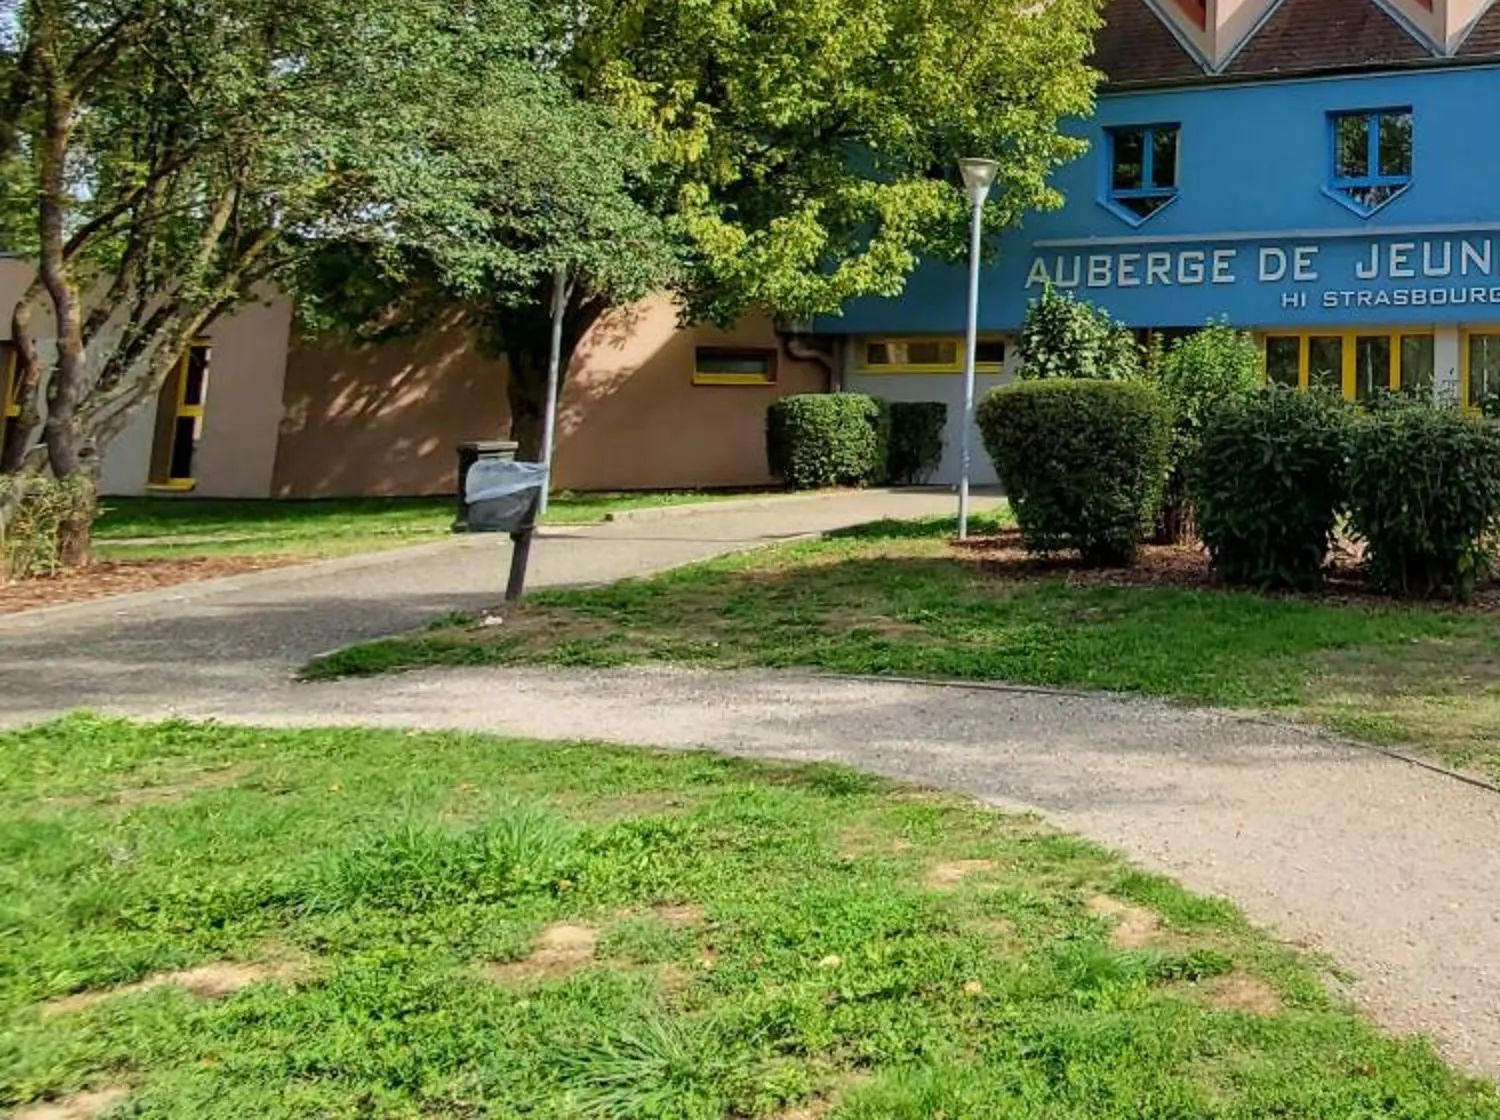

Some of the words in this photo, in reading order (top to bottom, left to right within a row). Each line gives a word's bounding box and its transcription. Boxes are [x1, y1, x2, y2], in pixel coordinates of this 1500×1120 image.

[1025, 249, 1236, 289] AUBERGE
[1258, 246, 1318, 281] DE
[1281, 292, 1306, 308] HI
